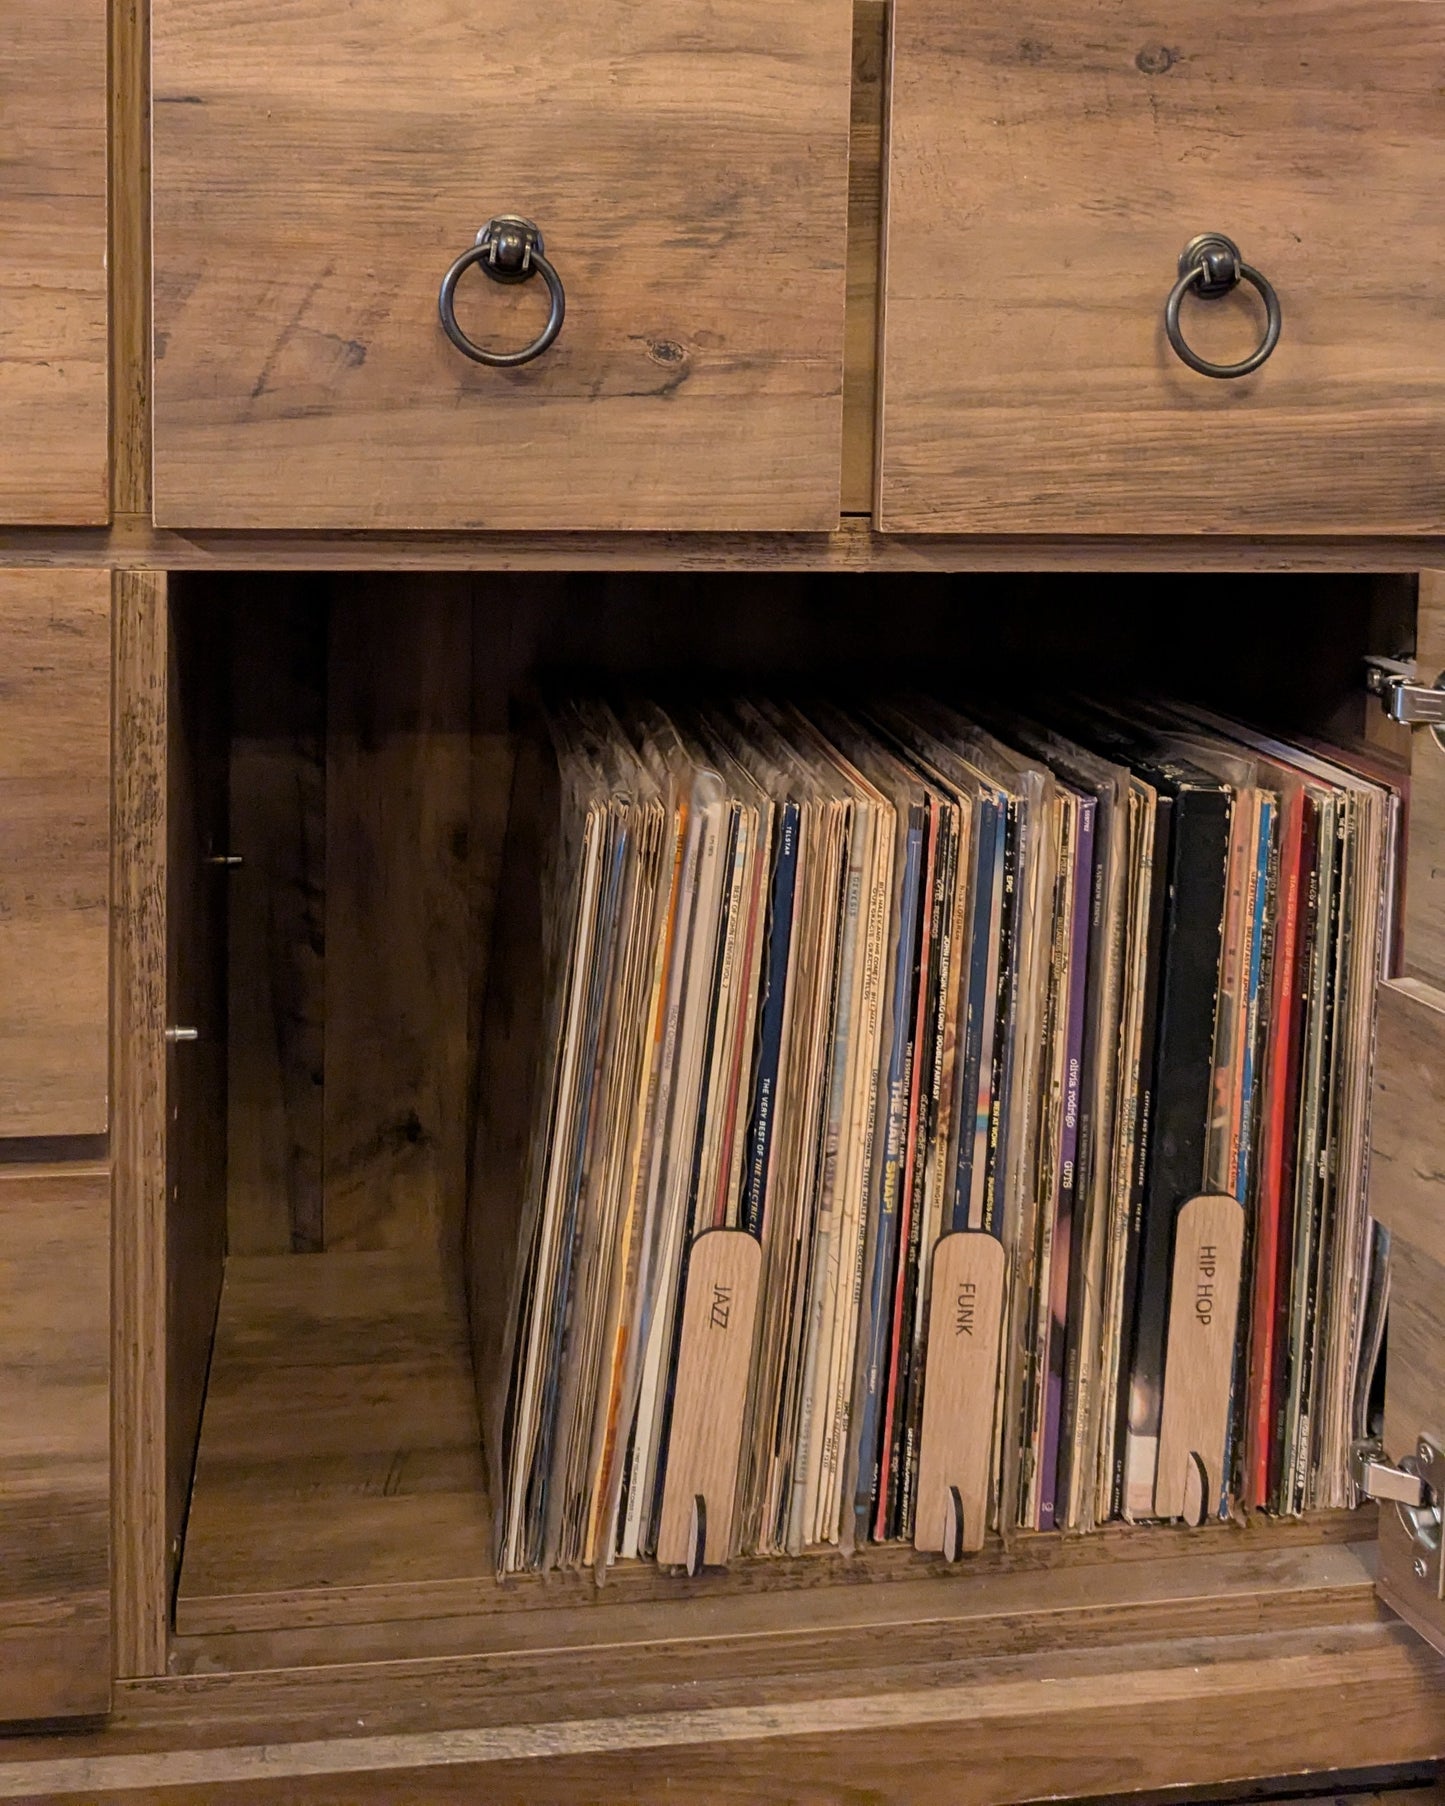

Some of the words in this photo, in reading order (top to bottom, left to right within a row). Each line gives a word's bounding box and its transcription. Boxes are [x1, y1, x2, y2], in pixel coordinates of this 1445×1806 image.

[784, 826, 792, 855] TELSTAR
[732, 886, 740, 904] BEST
[850, 876, 859, 918] GENESIS
[1005, 874, 1013, 893] EPIC
[1288, 874, 1296, 902] STATUS
[731, 906, 738, 915] OF
[931, 906, 940, 939] RECORDS
[1093, 901, 1101, 927] RISING
[729, 916, 738, 936] JOHN
[726, 937, 736, 966] DENVER
[942, 936, 951, 955] JOHN
[938, 1013, 946, 1030] ONO
[934, 1035, 944, 1064] DOUBLE
[762, 1078, 770, 1094] THE
[870, 1068, 878, 1094] LOVE'S
[902, 1058, 911, 1096] ESSENTIAL
[932, 1066, 942, 1100] FANTASY
[1068, 1058, 1079, 1088] olivia
[760, 1096, 769, 1118] VERY
[890, 1080, 902, 1113] THE
[918, 1094, 928, 1122] GLADYS
[992, 1100, 1000, 1116] MEN
[1065, 1090, 1078, 1128] rodrigo
[868, 1104, 876, 1129] PRIMA
[992, 1118, 998, 1126] AT
[758, 1120, 766, 1142] BEST
[887, 1116, 900, 1156] JAM
[990, 1126, 998, 1148] WORK
[756, 1144, 765, 1156] OF
[865, 1132, 873, 1160] DONNA
[754, 1158, 763, 1176] THE
[914, 1171, 922, 1186] THE
[936, 1158, 944, 1182] AFTER
[1063, 1160, 1073, 1189] GUTS
[1138, 1148, 1146, 1186] BOTTLEMEN
[750, 1178, 762, 1221] ELECTRIC
[882, 1160, 896, 1214] SNAP!
[933, 1184, 942, 1208] NIGHT
[908, 1246, 916, 1262] HITS
[1200, 1246, 1217, 1277] HIP
[710, 1282, 732, 1329] JAZZ
[956, 1283, 976, 1336] FUNK
[1195, 1284, 1213, 1326] HOP
